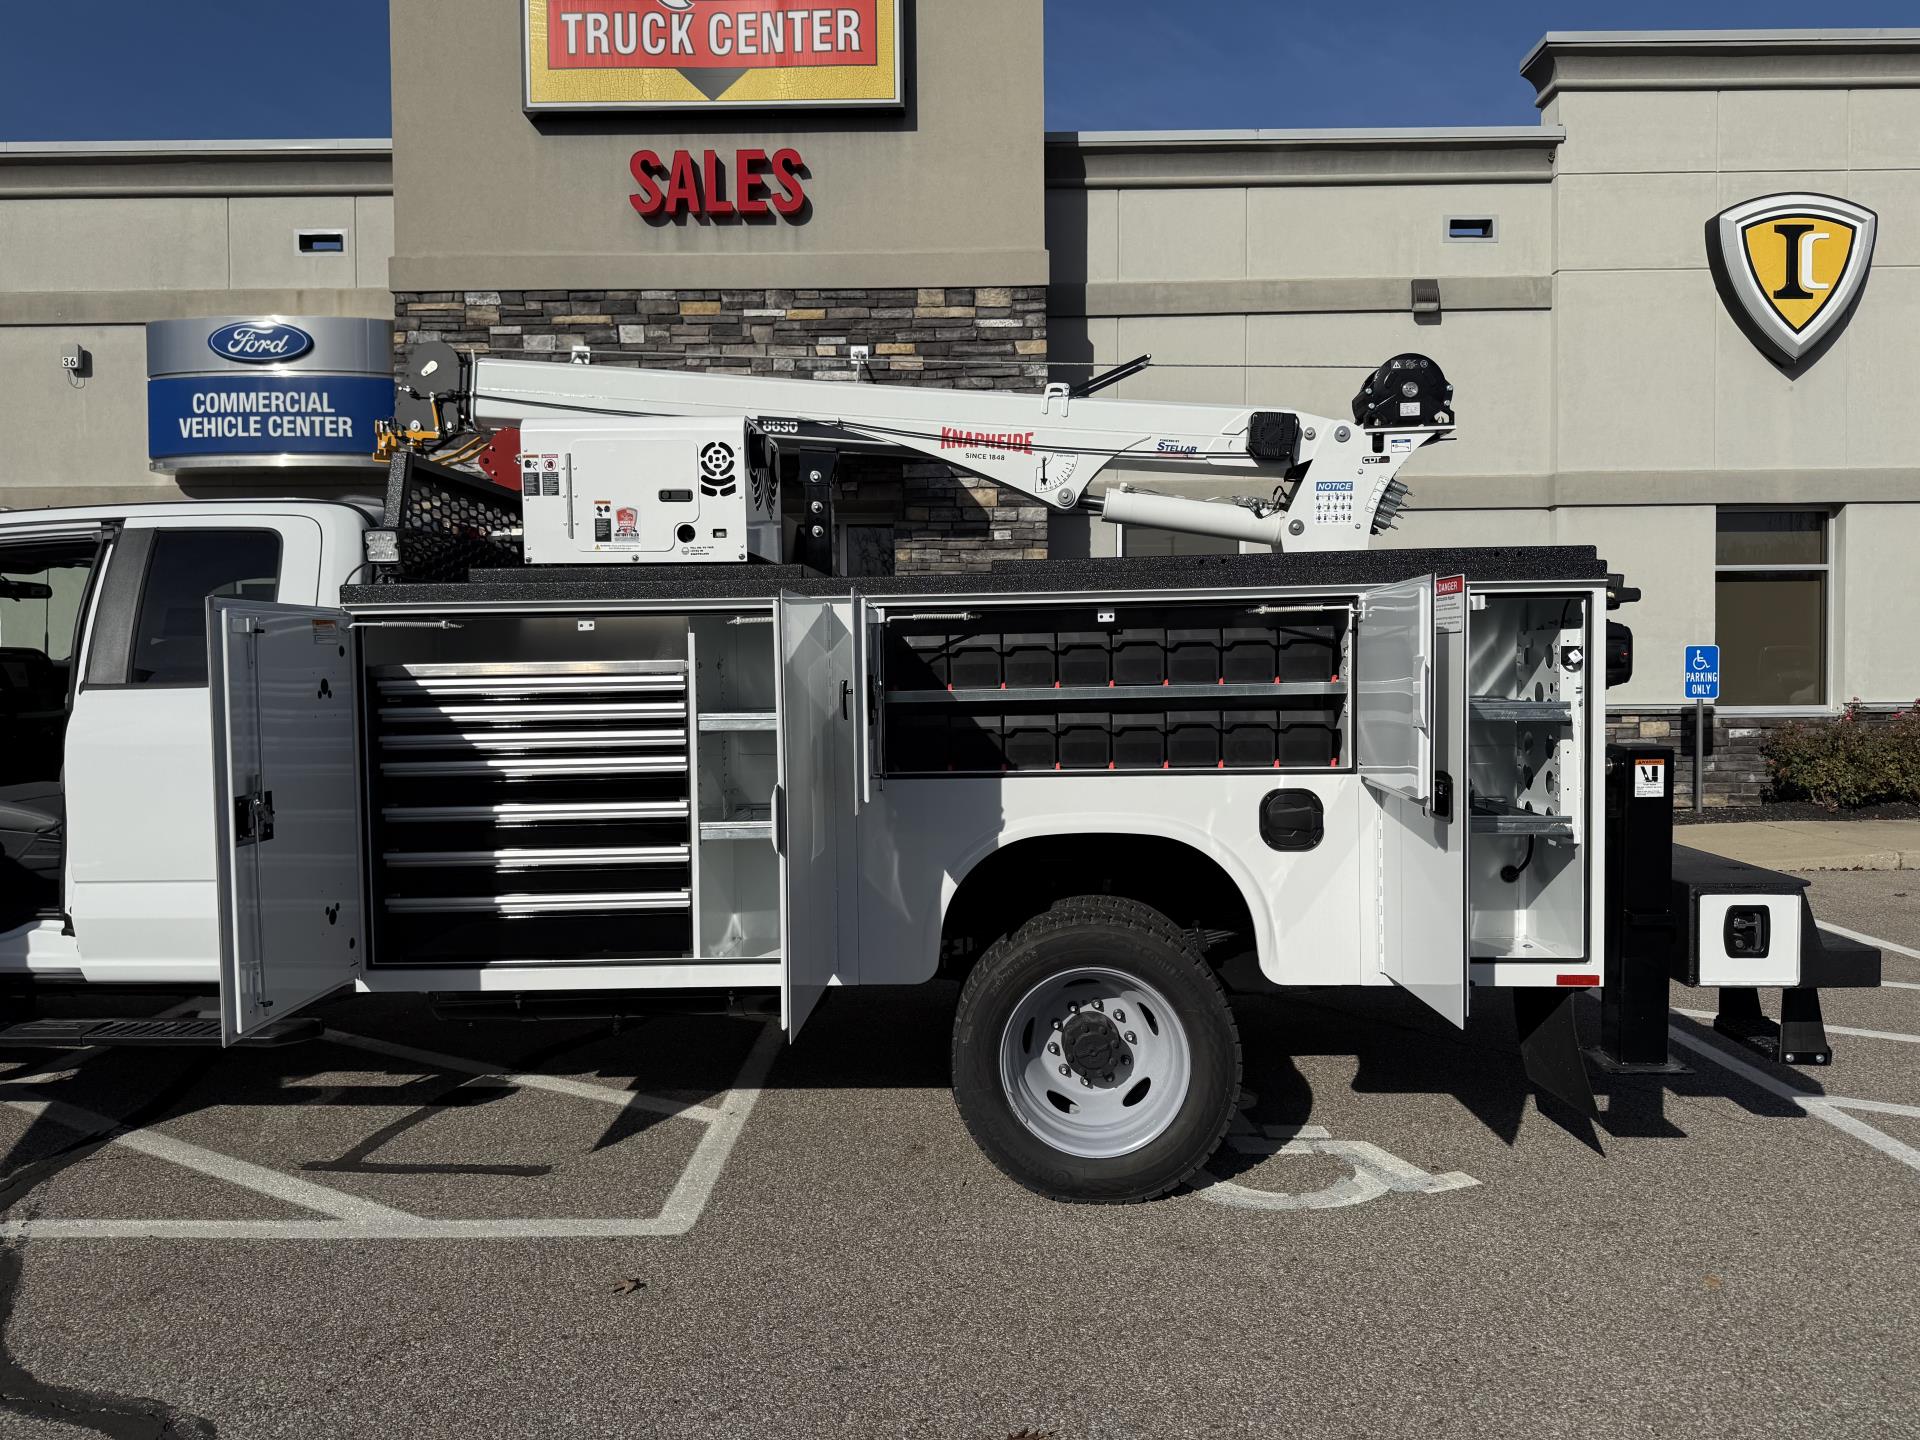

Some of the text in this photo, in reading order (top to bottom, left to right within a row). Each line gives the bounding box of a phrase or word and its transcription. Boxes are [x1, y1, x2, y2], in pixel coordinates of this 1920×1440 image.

[560, 9, 862, 55] TRUCK CENTER
[629, 149, 804, 215] SALES
[227, 328, 289, 354] Ford
[63, 357, 76, 367] 36
[192, 392, 336, 416] COMMERCIAL
[179, 416, 353, 439] VEHICLE CENTER
[940, 426, 1034, 455] KNAPHEIDE
[1157, 441, 1198, 454] STELLAR
[965, 452, 987, 460] SINCE
[1317, 482, 1352, 490] NOTICE
[1438, 581, 1458, 593] DANGER
[1686, 672, 1718, 682] PARKING
[1691, 684, 1711, 695] ONLY
